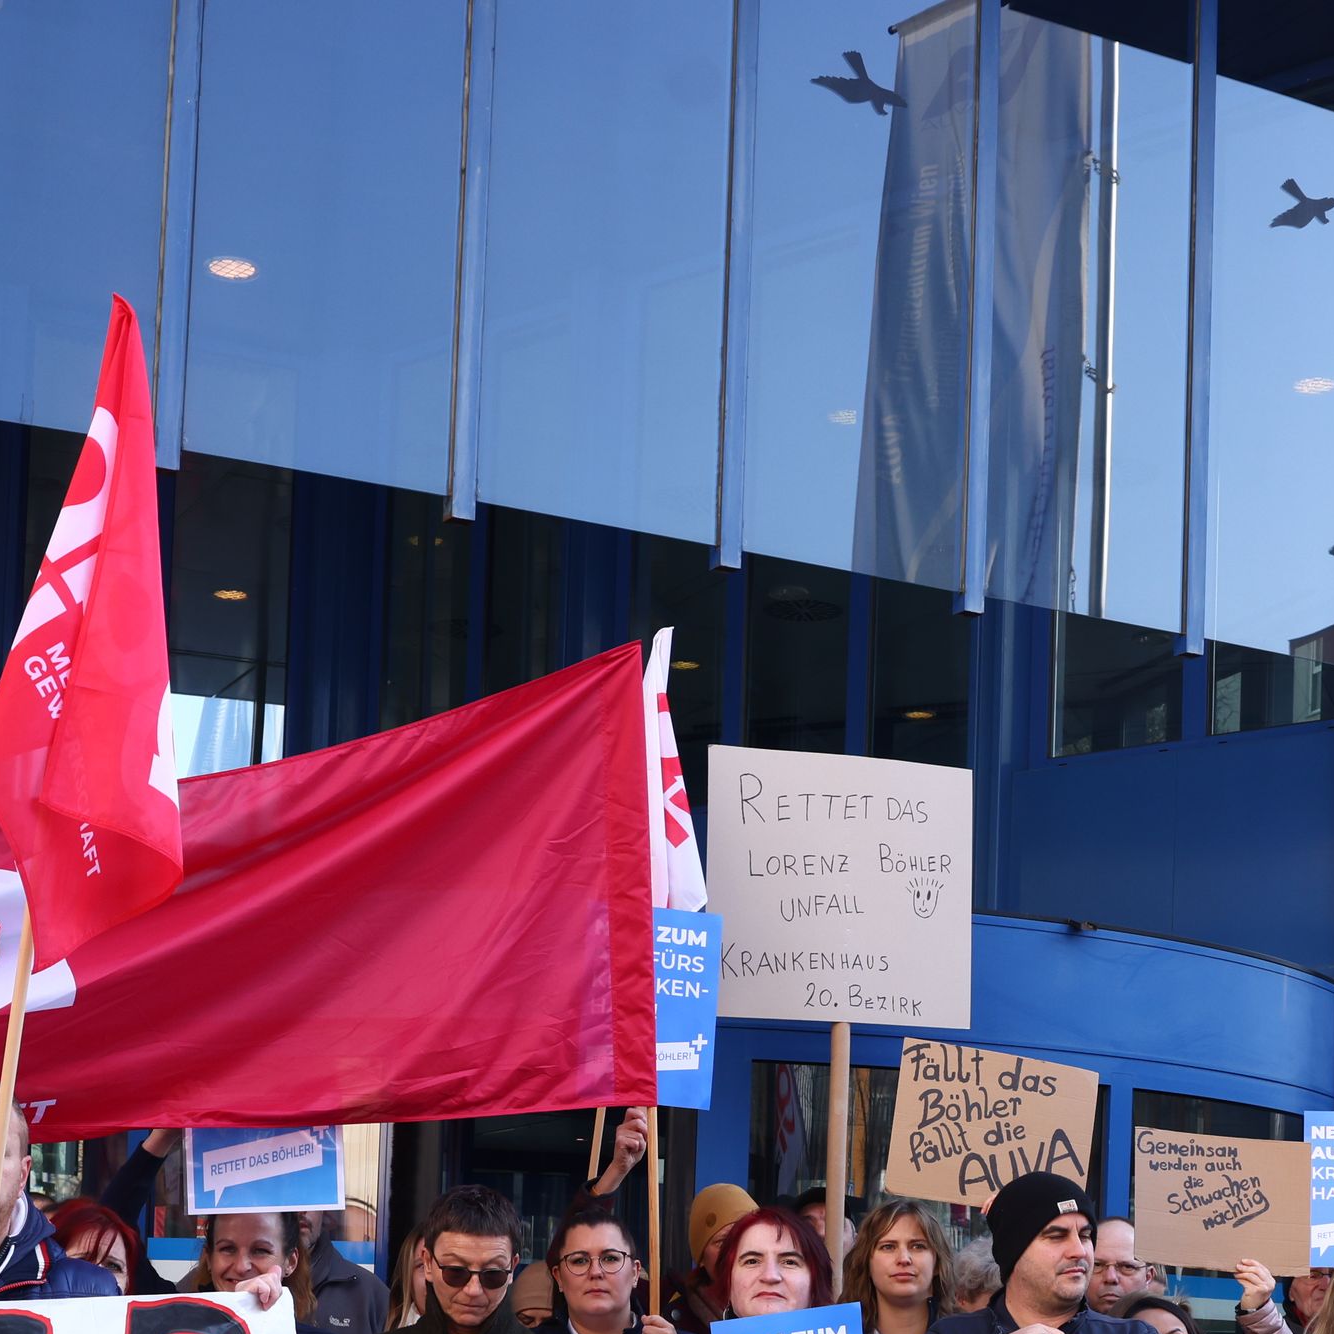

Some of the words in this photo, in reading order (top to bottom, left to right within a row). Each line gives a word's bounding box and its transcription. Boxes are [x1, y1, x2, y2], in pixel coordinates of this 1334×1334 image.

[739, 773, 874, 825] RETTET
[886, 796, 929, 824] DAS
[749, 849, 851, 878] LORENZ
[879, 842, 953, 875] BÖHLER
[780, 893, 865, 922] UNFALL
[657, 926, 708, 948] ZUM
[721, 942, 890, 978] KRANKENHAUS
[803, 982, 839, 1009] 20.
[849, 984, 924, 1017] BEZIRK
[903, 1043, 984, 1086] Fällt
[998, 1057, 1058, 1097] das
[918, 1086, 1022, 1130] Böhler
[210, 1156, 248, 1176] RETTET
[248, 1151, 270, 1169] DAS
[271, 1142, 315, 1163] BÖHLER!
[910, 1122, 972, 1172] fällt
[983, 1121, 1027, 1146] die
[958, 1128, 1085, 1196] AUVA
[1137, 1131, 1239, 1158] Gemeinsam
[1149, 1159, 1198, 1171] werden
[1205, 1156, 1242, 1173] auch
[1183, 1175, 1205, 1189] die
[1167, 1174, 1262, 1215] Schwachen
